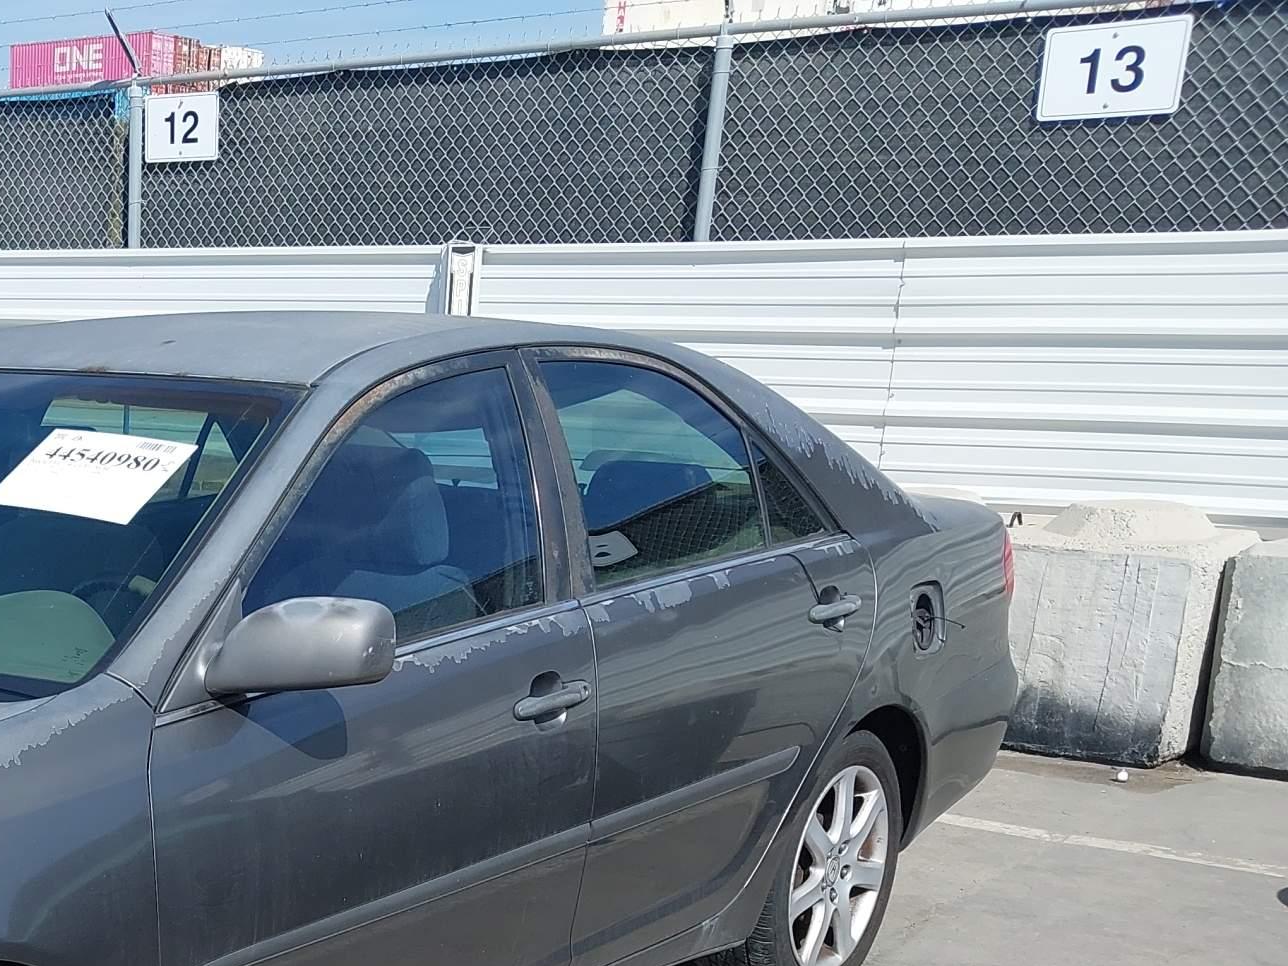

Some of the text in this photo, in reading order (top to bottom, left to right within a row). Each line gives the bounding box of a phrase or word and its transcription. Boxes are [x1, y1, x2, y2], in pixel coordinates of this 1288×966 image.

[55, 43, 104, 73] ONE
[1079, 45, 1146, 94] 13
[164, 110, 199, 145] 12
[44, 446, 161, 472] 44540980
